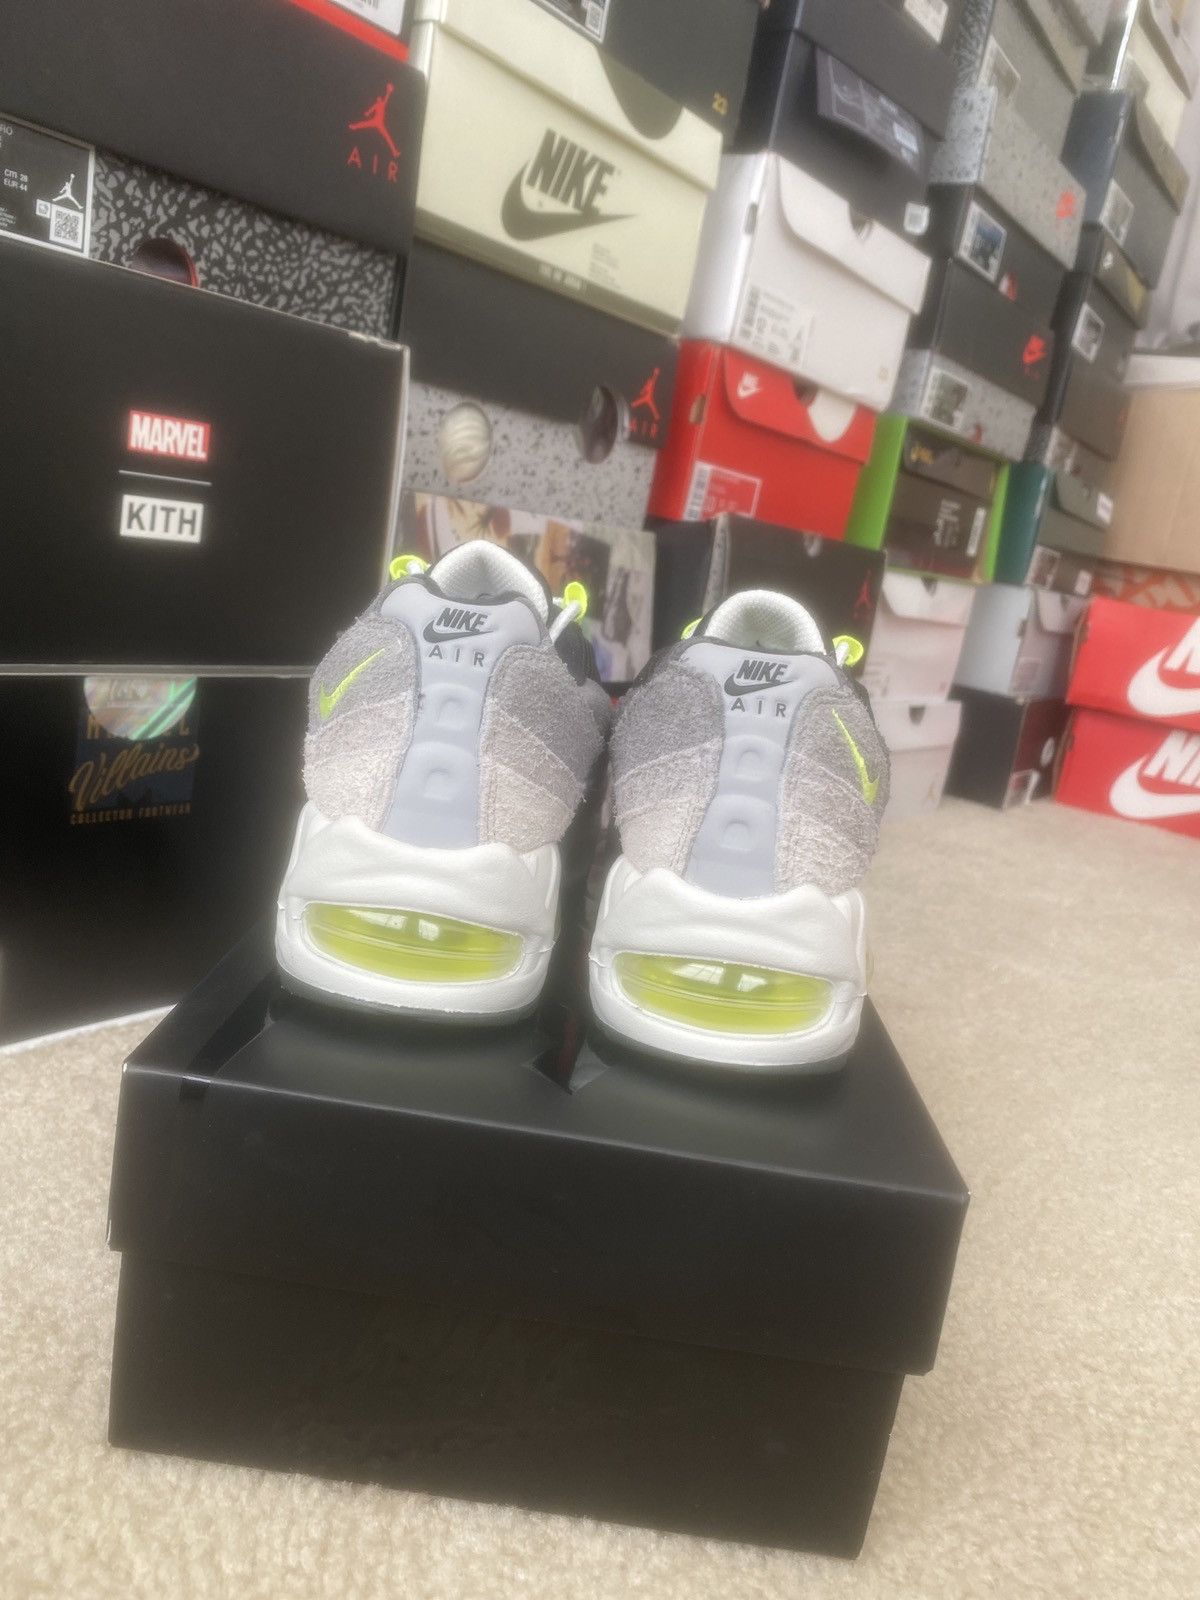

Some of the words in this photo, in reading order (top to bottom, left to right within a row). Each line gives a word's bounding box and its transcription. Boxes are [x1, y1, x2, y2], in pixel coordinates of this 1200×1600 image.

[345, 145, 399, 183] AIR
[525, 128, 616, 216] NIKE
[3, 177, 18, 189] EUR
[20, 183, 28, 192] 44
[130, 413, 208, 460] MARVEL
[126, 501, 197, 536] KITH
[436, 607, 488, 632] NIKE
[428, 644, 485, 667] AIR
[736, 659, 788, 683] NIKE
[731, 697, 787, 718] AIR
[67, 743, 200, 812] Villains
